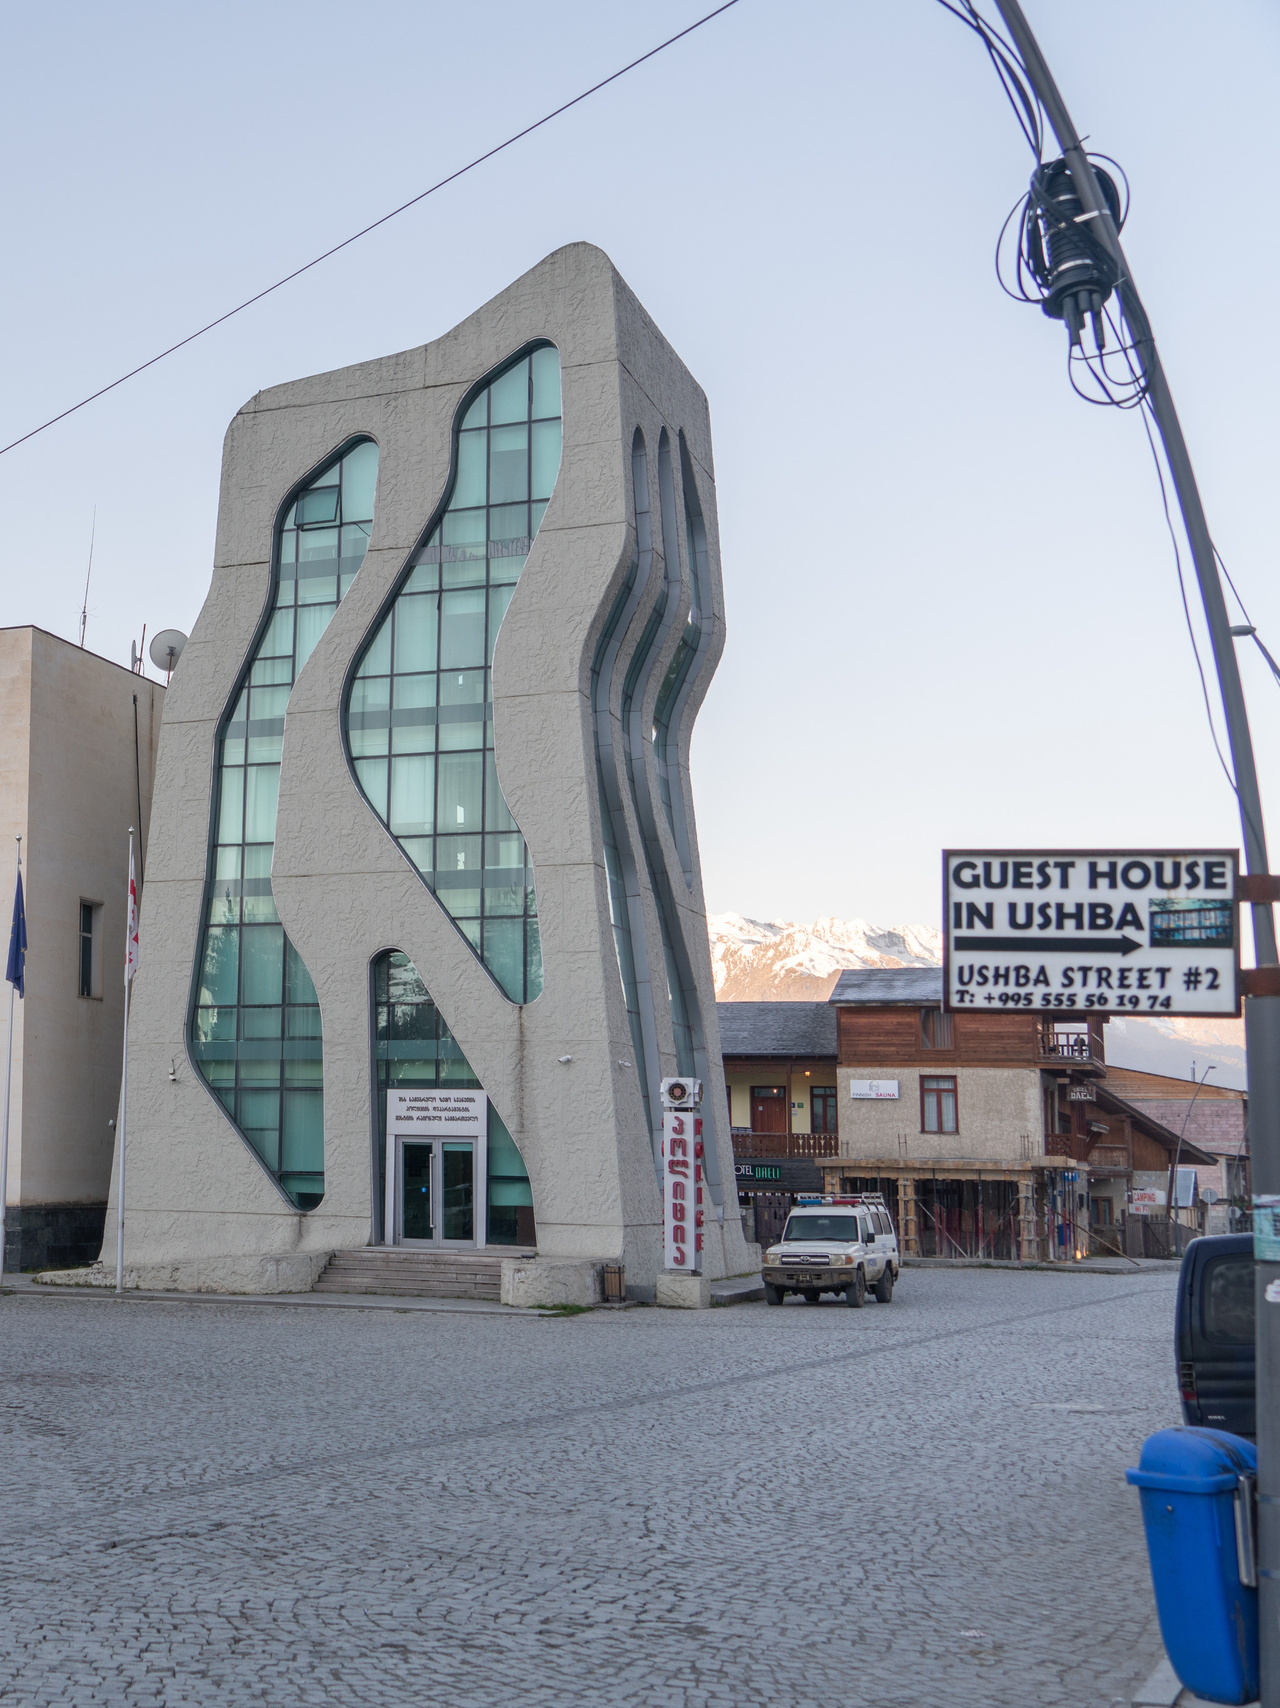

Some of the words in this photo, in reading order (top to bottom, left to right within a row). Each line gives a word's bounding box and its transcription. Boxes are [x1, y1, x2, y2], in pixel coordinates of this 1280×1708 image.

[952, 861, 1075, 890] GUEST
[1088, 861, 1228, 890] HOUSE
[953, 902, 994, 930] IN
[1008, 901, 1145, 931] USHBA
[957, 964, 1051, 987] USHBA
[1060, 966, 1171, 990] STREET
[1183, 966, 1220, 991] #2
[956, 990, 975, 1004] T:
[984, 992, 1033, 1007] +995
[1040, 993, 1077, 1008] 555
[1084, 992, 1108, 1008] 56
[1116, 994, 1140, 1009] 19
[1147, 995, 1172, 1009] 74
[734, 1164, 754, 1176] OTEL
[755, 1166, 781, 1179] DAELI
[668, 1116, 689, 1265] პოლიცია
[1133, 1192, 1156, 1203] CAMPING
